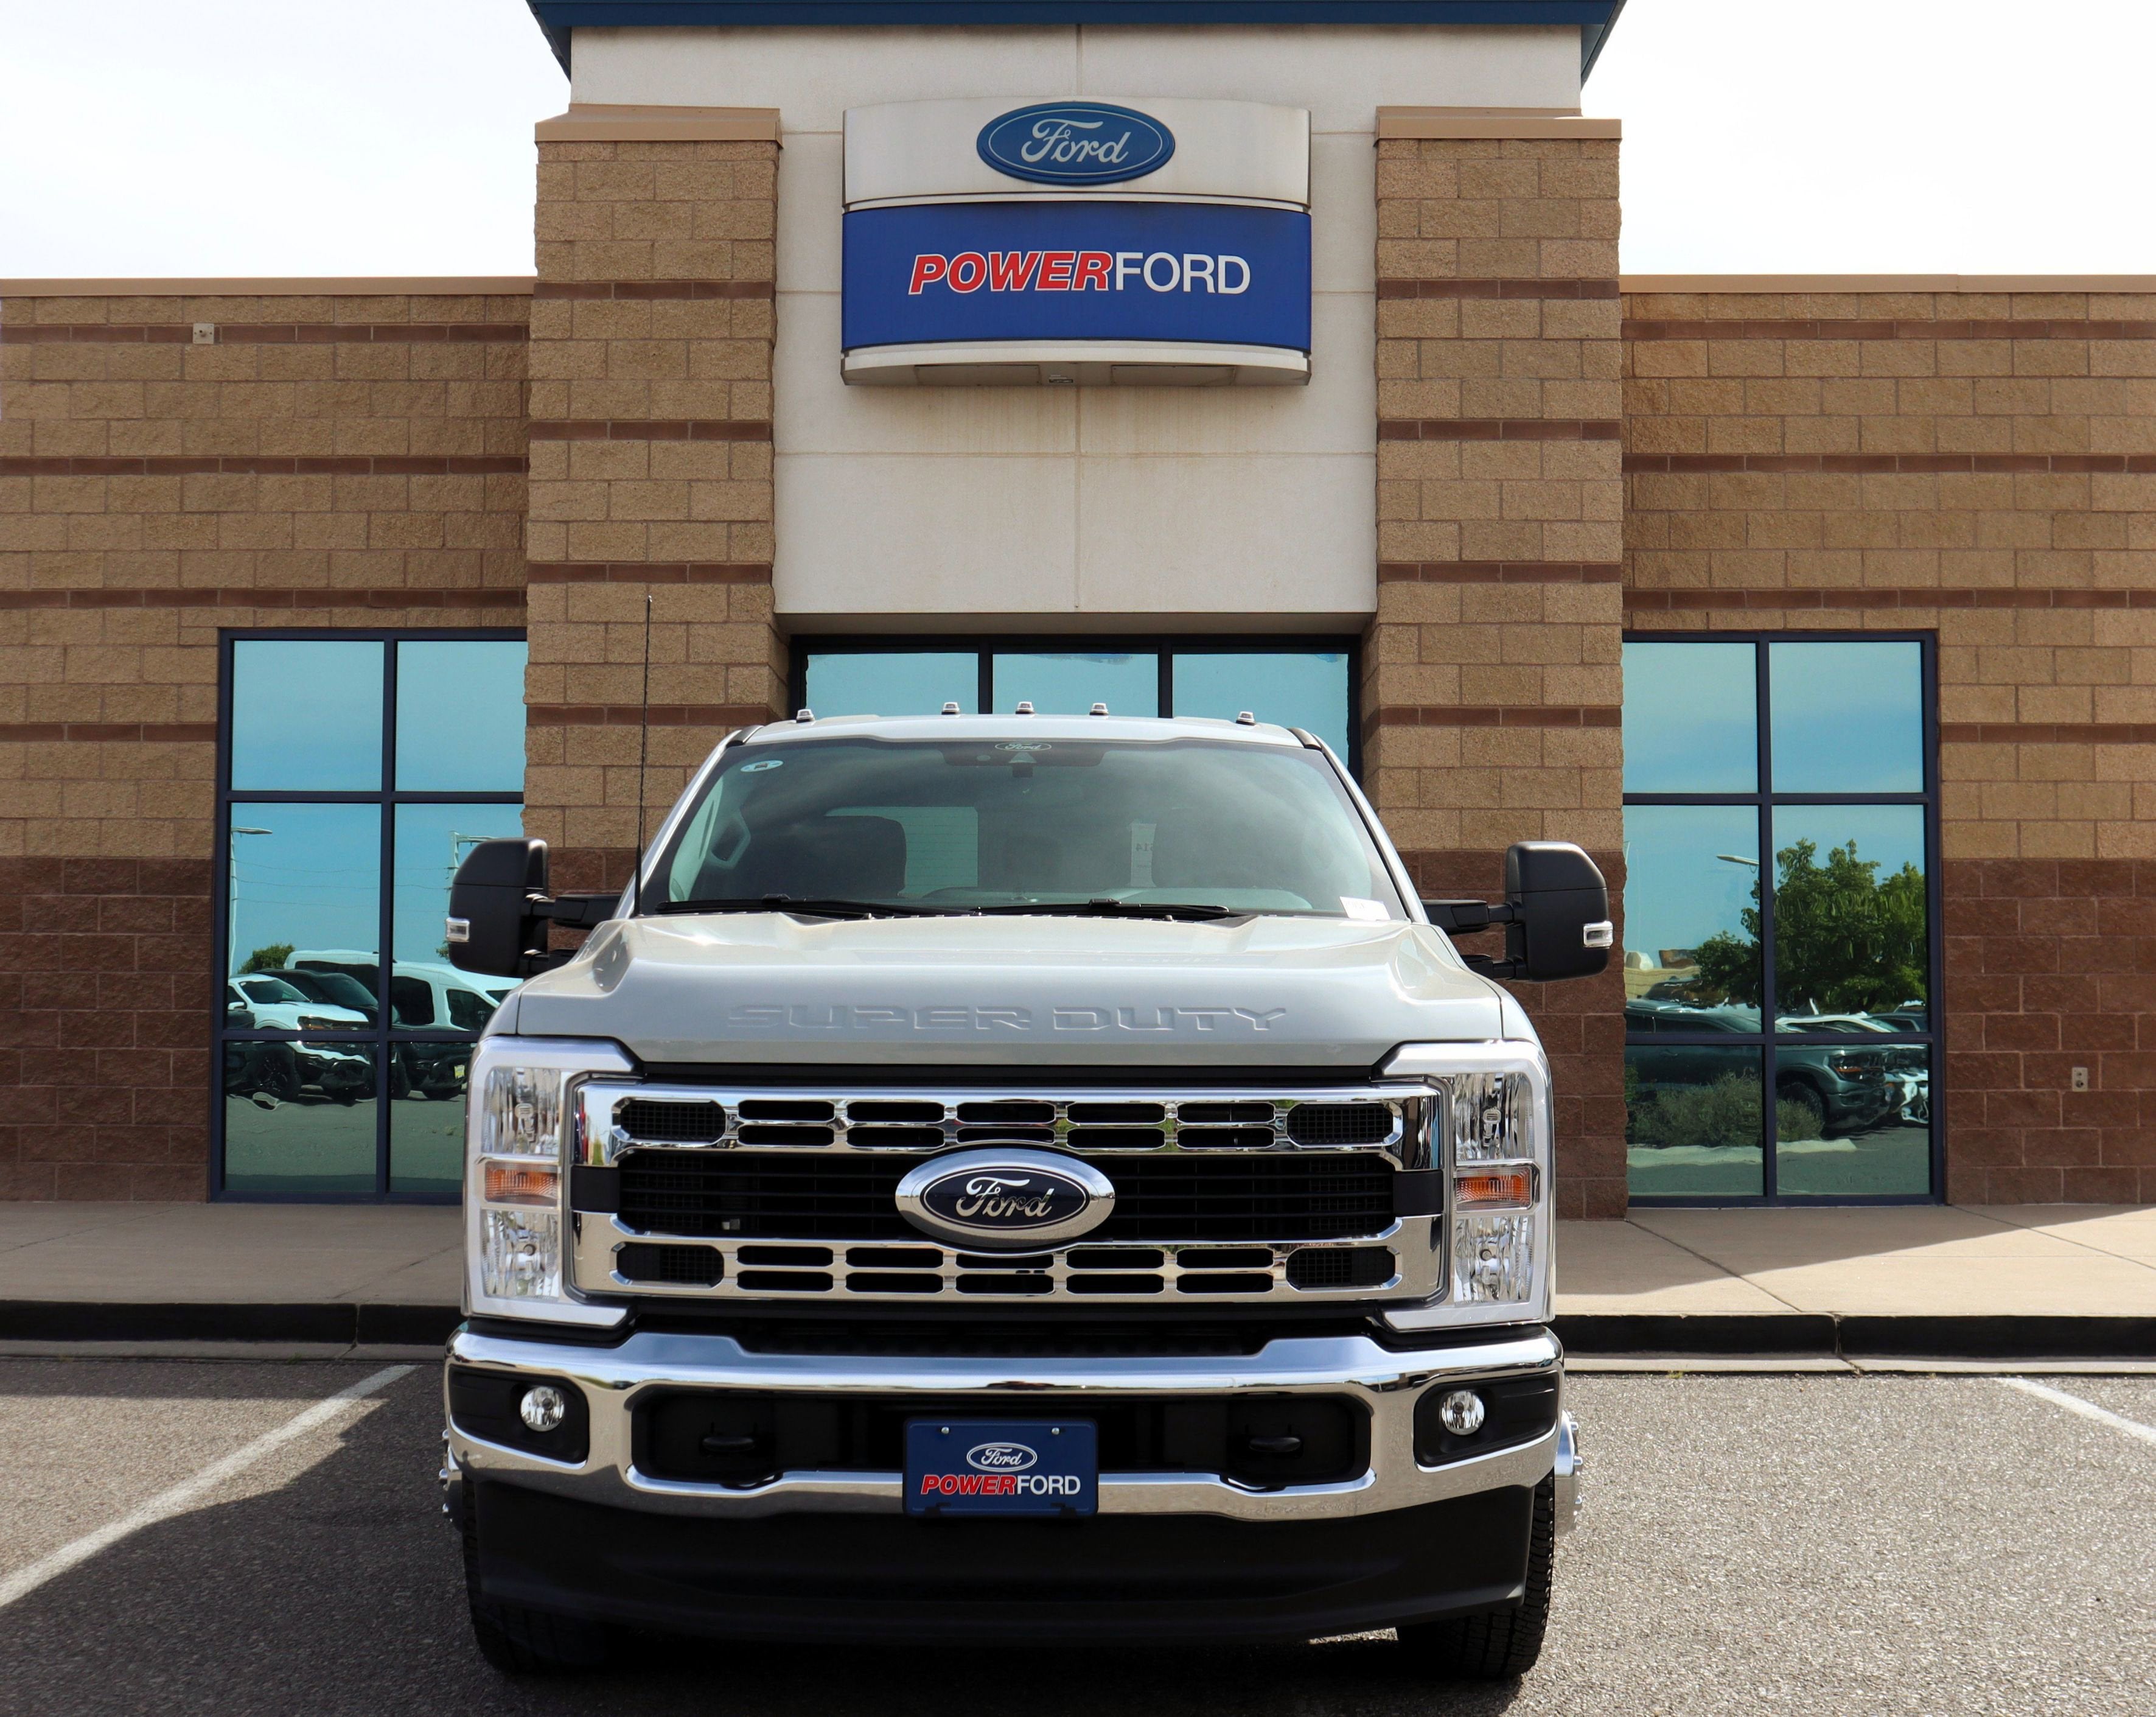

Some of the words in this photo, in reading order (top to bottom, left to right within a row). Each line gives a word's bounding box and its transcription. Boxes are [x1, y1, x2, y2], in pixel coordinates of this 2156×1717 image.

[1021, 118, 1131, 163] Ford
[728, 1005, 1032, 1030] SUPER
[1053, 1007, 1286, 1030] DUTY
[956, 1177, 1055, 1217] Ford
[980, 1447, 1022, 1466] Ford
